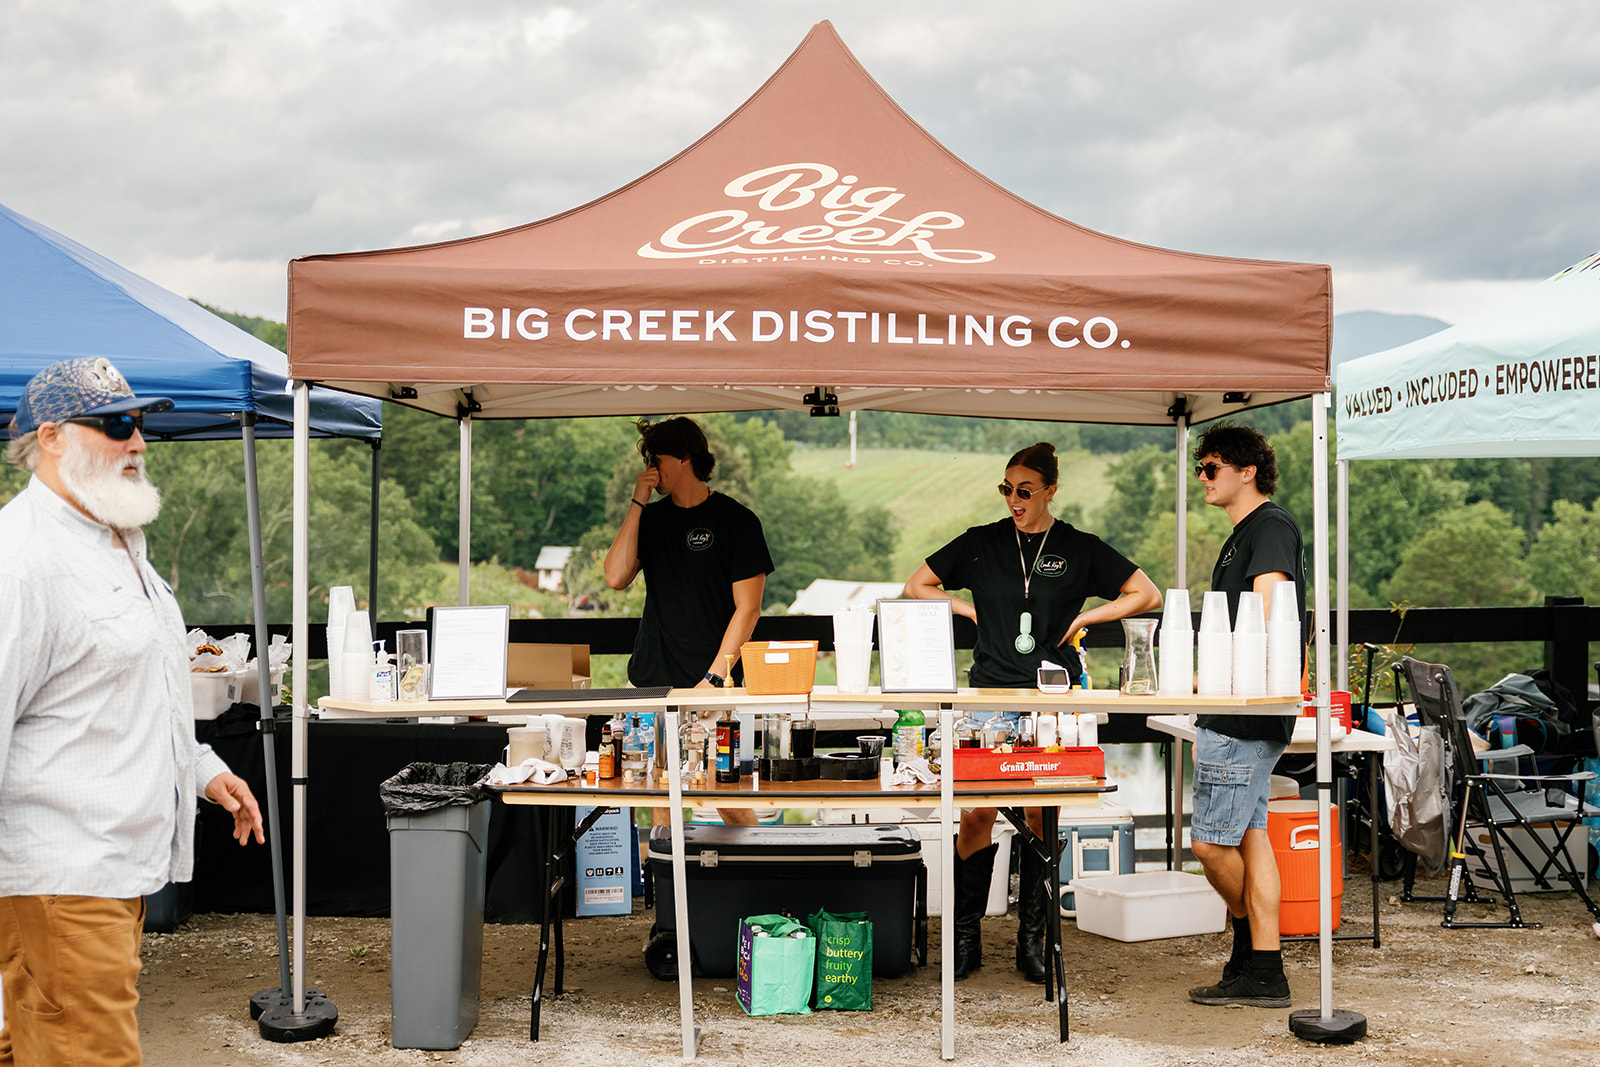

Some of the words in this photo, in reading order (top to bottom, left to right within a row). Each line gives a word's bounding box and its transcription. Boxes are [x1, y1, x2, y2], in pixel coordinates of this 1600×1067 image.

[724, 163, 906, 227] Big
[637, 209, 996, 264] Creek
[698, 255, 871, 265] DISTILLING
[883, 259, 934, 267] CO.
[463, 307, 549, 341] BIG
[564, 308, 738, 342] CREEK
[752, 309, 1032, 348] DISTILLING
[1048, 315, 1131, 349] CO.
[1345, 386, 1392, 419] VALUED
[1406, 368, 1478, 408] INCLUDED
[1496, 354, 1600, 395] EMPOWERE
[1000, 761, 1025, 773] Grand
[1025, 761, 1059, 772] Marnier
[827, 935, 851, 947] crisp
[826, 947, 864, 960] buttery
[825, 959, 853, 972] fruity
[825, 973, 858, 985] earthy
